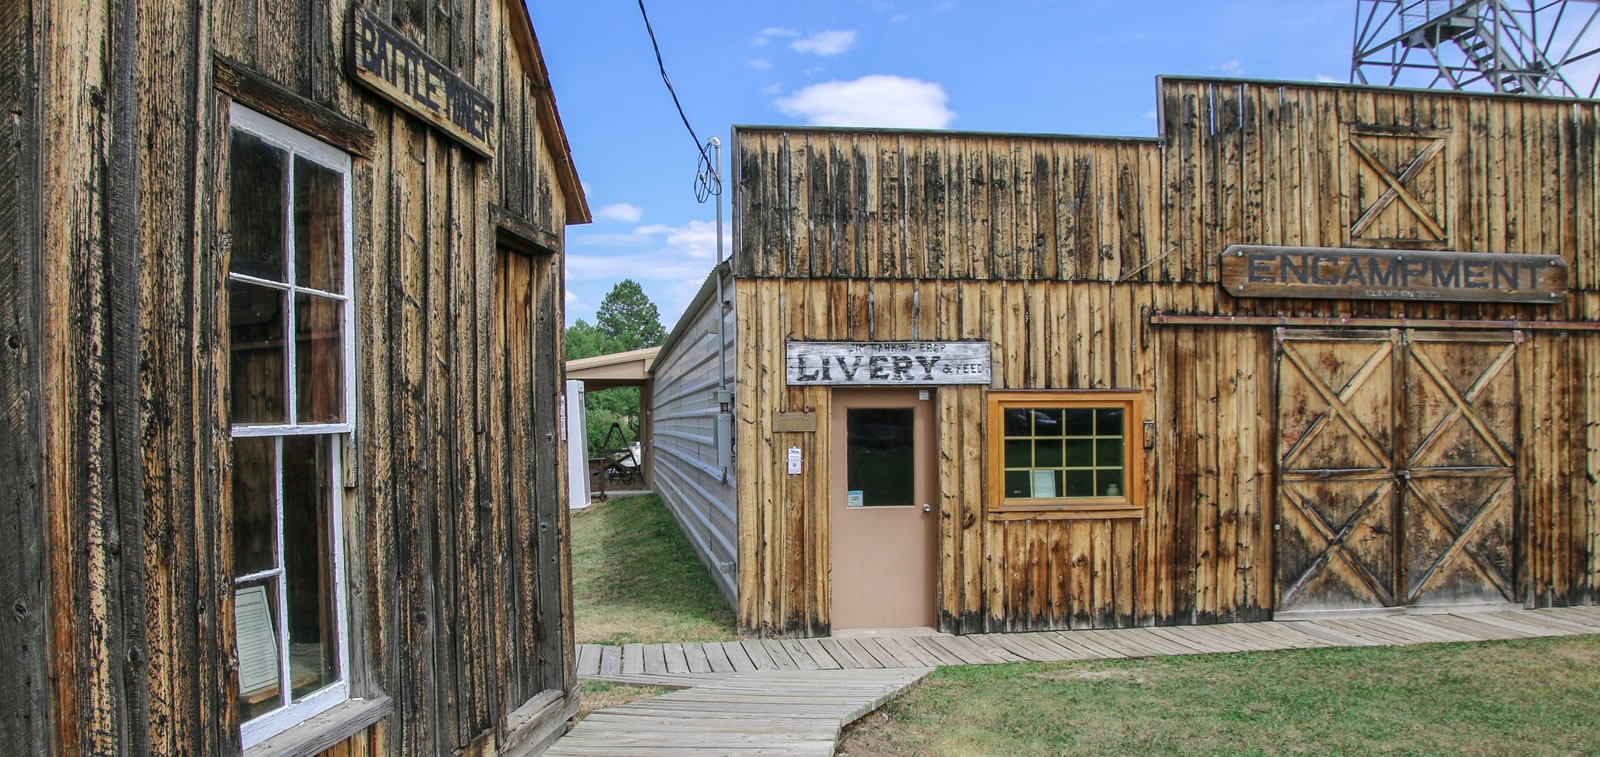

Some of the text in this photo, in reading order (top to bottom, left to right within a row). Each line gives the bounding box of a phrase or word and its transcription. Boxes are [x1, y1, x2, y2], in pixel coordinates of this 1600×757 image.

[361, 16, 493, 146] BATTLE MINER
[1248, 254, 1547, 289] ENCAMPMENT
[796, 354, 941, 382] LIVERY
[956, 363, 983, 374] FEED
